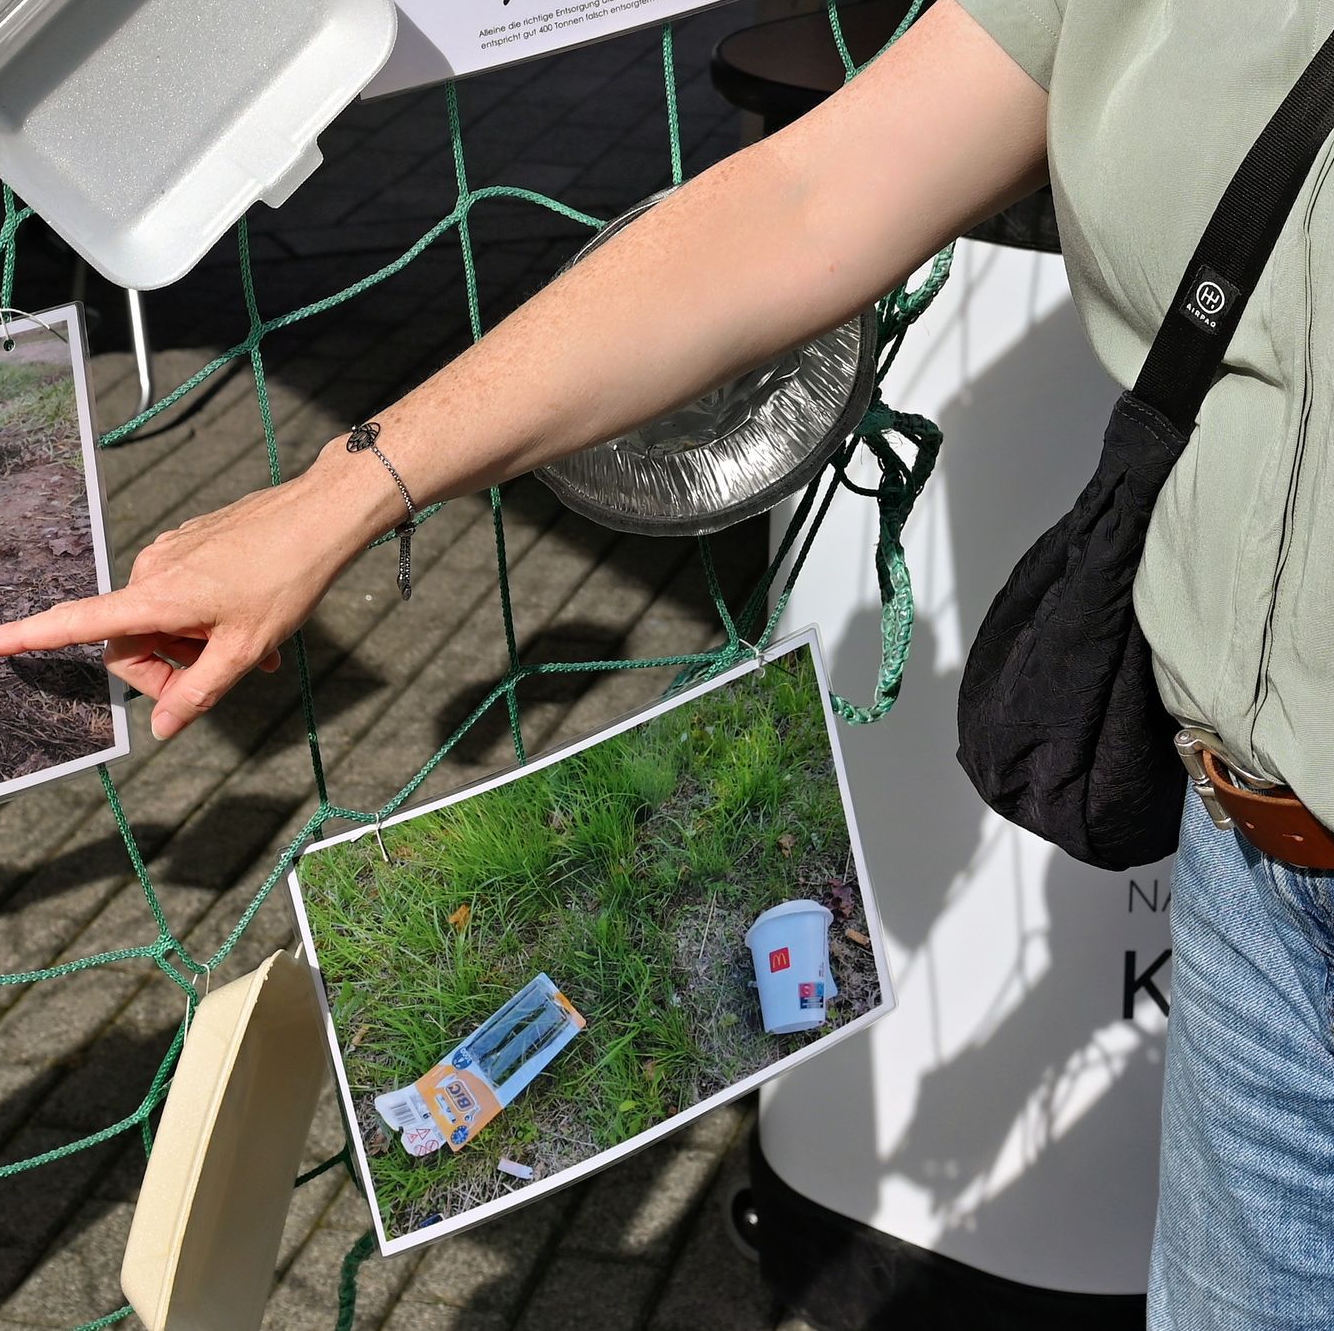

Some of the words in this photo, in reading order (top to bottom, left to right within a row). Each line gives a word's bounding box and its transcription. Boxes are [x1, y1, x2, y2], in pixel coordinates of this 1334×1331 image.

[478, 25, 507, 38] Alleine
[508, 21, 521, 30] die
[523, 12, 554, 26] richtige
[555, 0, 600, 17] Entsorgung
[481, 32, 521, 50] entspricht
[522, 29, 537, 40] gut
[538, 23, 553, 34] 400
[554, 16, 584, 29] Tonnen
[585, 8, 609, 21] falsch
[1128, 878, 1171, 913] N
